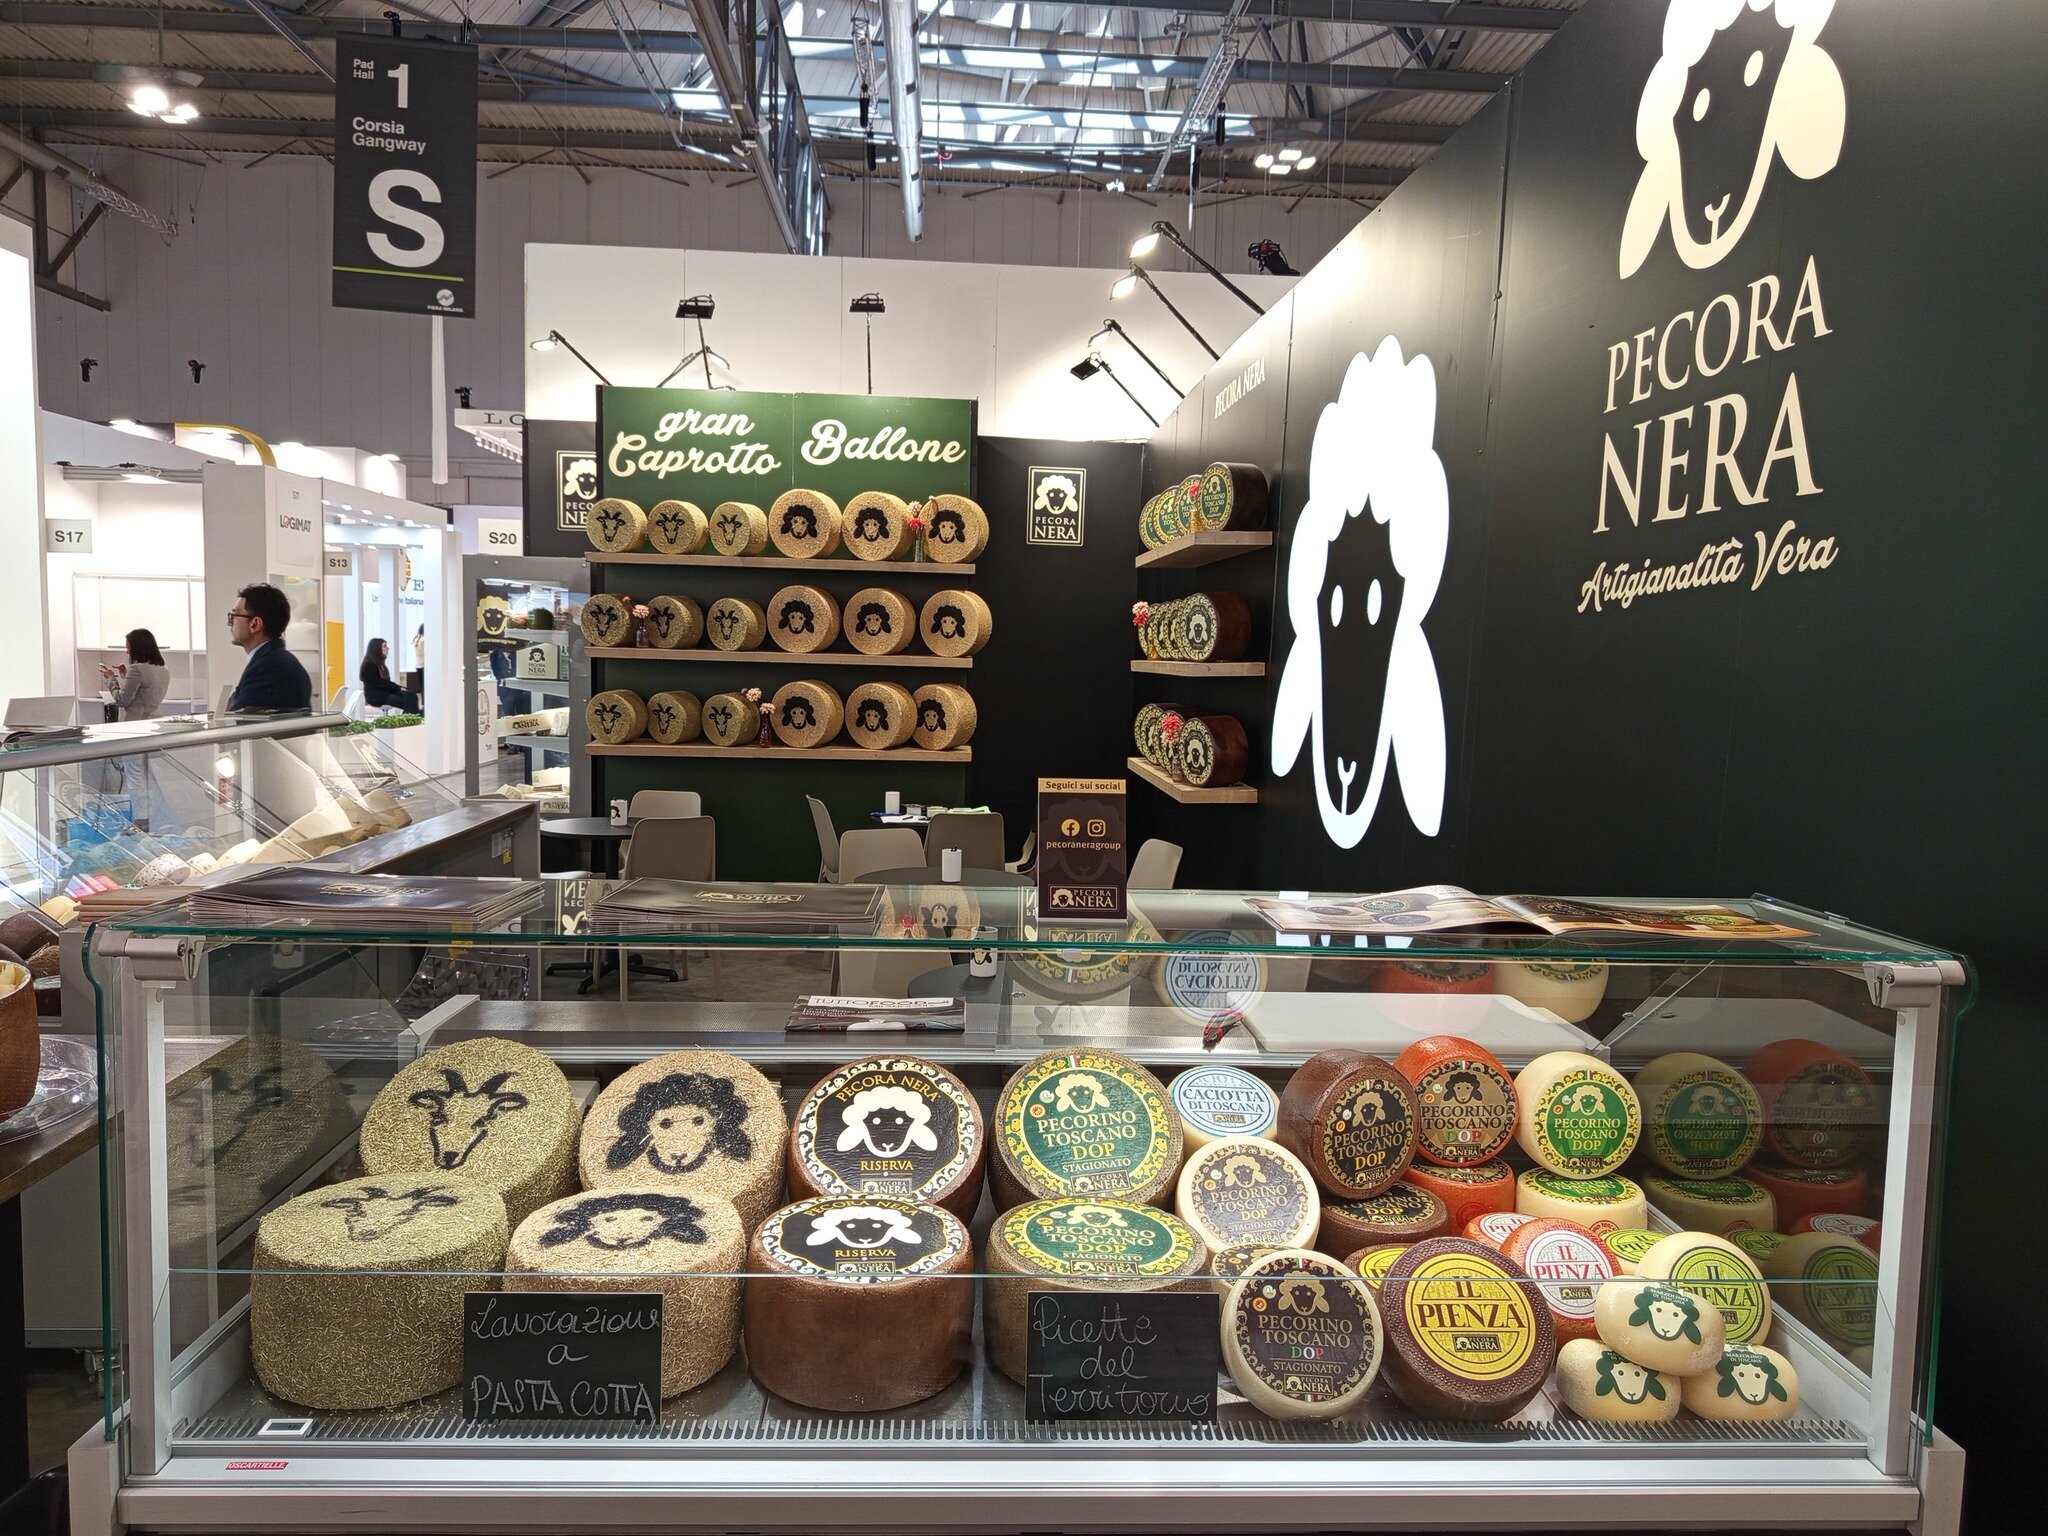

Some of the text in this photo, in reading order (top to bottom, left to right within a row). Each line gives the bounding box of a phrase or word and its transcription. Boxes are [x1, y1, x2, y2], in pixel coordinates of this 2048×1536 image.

[353, 58, 374, 69] Pad
[353, 69, 375, 80] Hall
[387, 63, 409, 109] 1
[352, 116, 405, 135] Corsia
[352, 132, 426, 155] Gangway
[366, 169, 445, 268] S
[1604, 254, 1833, 414] PECORA
[1214, 356, 1266, 420] PECORA NERA
[654, 408, 756, 443] gran
[801, 419, 967, 467] Ballone
[607, 431, 782, 480] Caprotto
[1592, 372, 1824, 534] NERA
[1036, 516, 1077, 526] PECORA
[54, 530, 84, 544] S17
[488, 532, 518, 545] S20
[1034, 526, 1077, 540] NERA
[1749, 519, 1839, 592] Vera
[329, 558, 348, 568] S13
[1045, 781, 1121, 791] Seguici sui social
[1046, 841, 1121, 851] pecoraneragroup
[1074, 896, 1114, 908] NERA
[836, 1074, 939, 1102] PECORA NERA
[1183, 1089, 1265, 1102] CACIOTTA
[1188, 1101, 1264, 1112] DI TOSCANA
[1421, 1104, 1506, 1118] PECORINO
[1037, 1110, 1137, 1134] PECORINO
[1424, 1117, 1502, 1130] TOSCANO
[1554, 1118, 1620, 1129] PECORINO
[1043, 1125, 1137, 1148] TOSCANO
[1334, 1120, 1405, 1148] PECORINO
[1444, 1131, 1483, 1143] DOP
[1555, 1128, 1618, 1140] TOSCANO
[1072, 1143, 1115, 1161] DOP
[1336, 1134, 1403, 1160] TOSCANO
[1572, 1139, 1601, 1151] DOP
[860, 1160, 914, 1171] RISERVA
[1062, 1158, 1131, 1174] STAGIONATO
[1354, 1151, 1386, 1171] DOP
[1091, 1173, 1123, 1182] PECORA
[1093, 1178, 1127, 1190] NERA
[1366, 1173, 1384, 1181] NERA
[880, 1185, 909, 1193] NERA
[1210, 1185, 1288, 1203] PECORINO
[803, 1200, 918, 1216] PECORA NERA
[1216, 1196, 1288, 1213] TOSCANO
[1366, 1207, 1404, 1215] DOP
[1241, 1209, 1268, 1221] DOP
[1042, 1226, 1156, 1238] PECORINO
[1229, 1219, 1284, 1232] STAGIONATO
[1048, 1233, 1154, 1247] TOSCANO
[835, 1249, 897, 1257] RISERVA
[1076, 1243, 1127, 1253] DOP
[1558, 1245, 1578, 1261] IL
[1063, 1252, 1143, 1261] STAGIONATO
[857, 1265, 891, 1273] NERA
[1533, 1263, 1605, 1281] PIENZA
[1452, 1275, 1482, 1298] IL
[1650, 1288, 1689, 1302] MARZOLINO
[1660, 1295, 1686, 1306] TOSCANA
[471, 1298, 661, 1339] Lavorazione
[1033, 1295, 1157, 1347] Ricette
[1415, 1303, 1528, 1329] PIENZA
[1258, 1315, 1353, 1334] PECORINO
[1262, 1329, 1351, 1349] TOSCANO
[1471, 1341, 1499, 1350] NERA
[547, 1343, 590, 1365] a
[1290, 1346, 1324, 1360] DOP
[1080, 1345, 1148, 1379] del
[1273, 1362, 1342, 1374] STAGIONATO
[1302, 1382, 1331, 1392] NERA
[471, 1375, 657, 1421] PASTA COTTA
